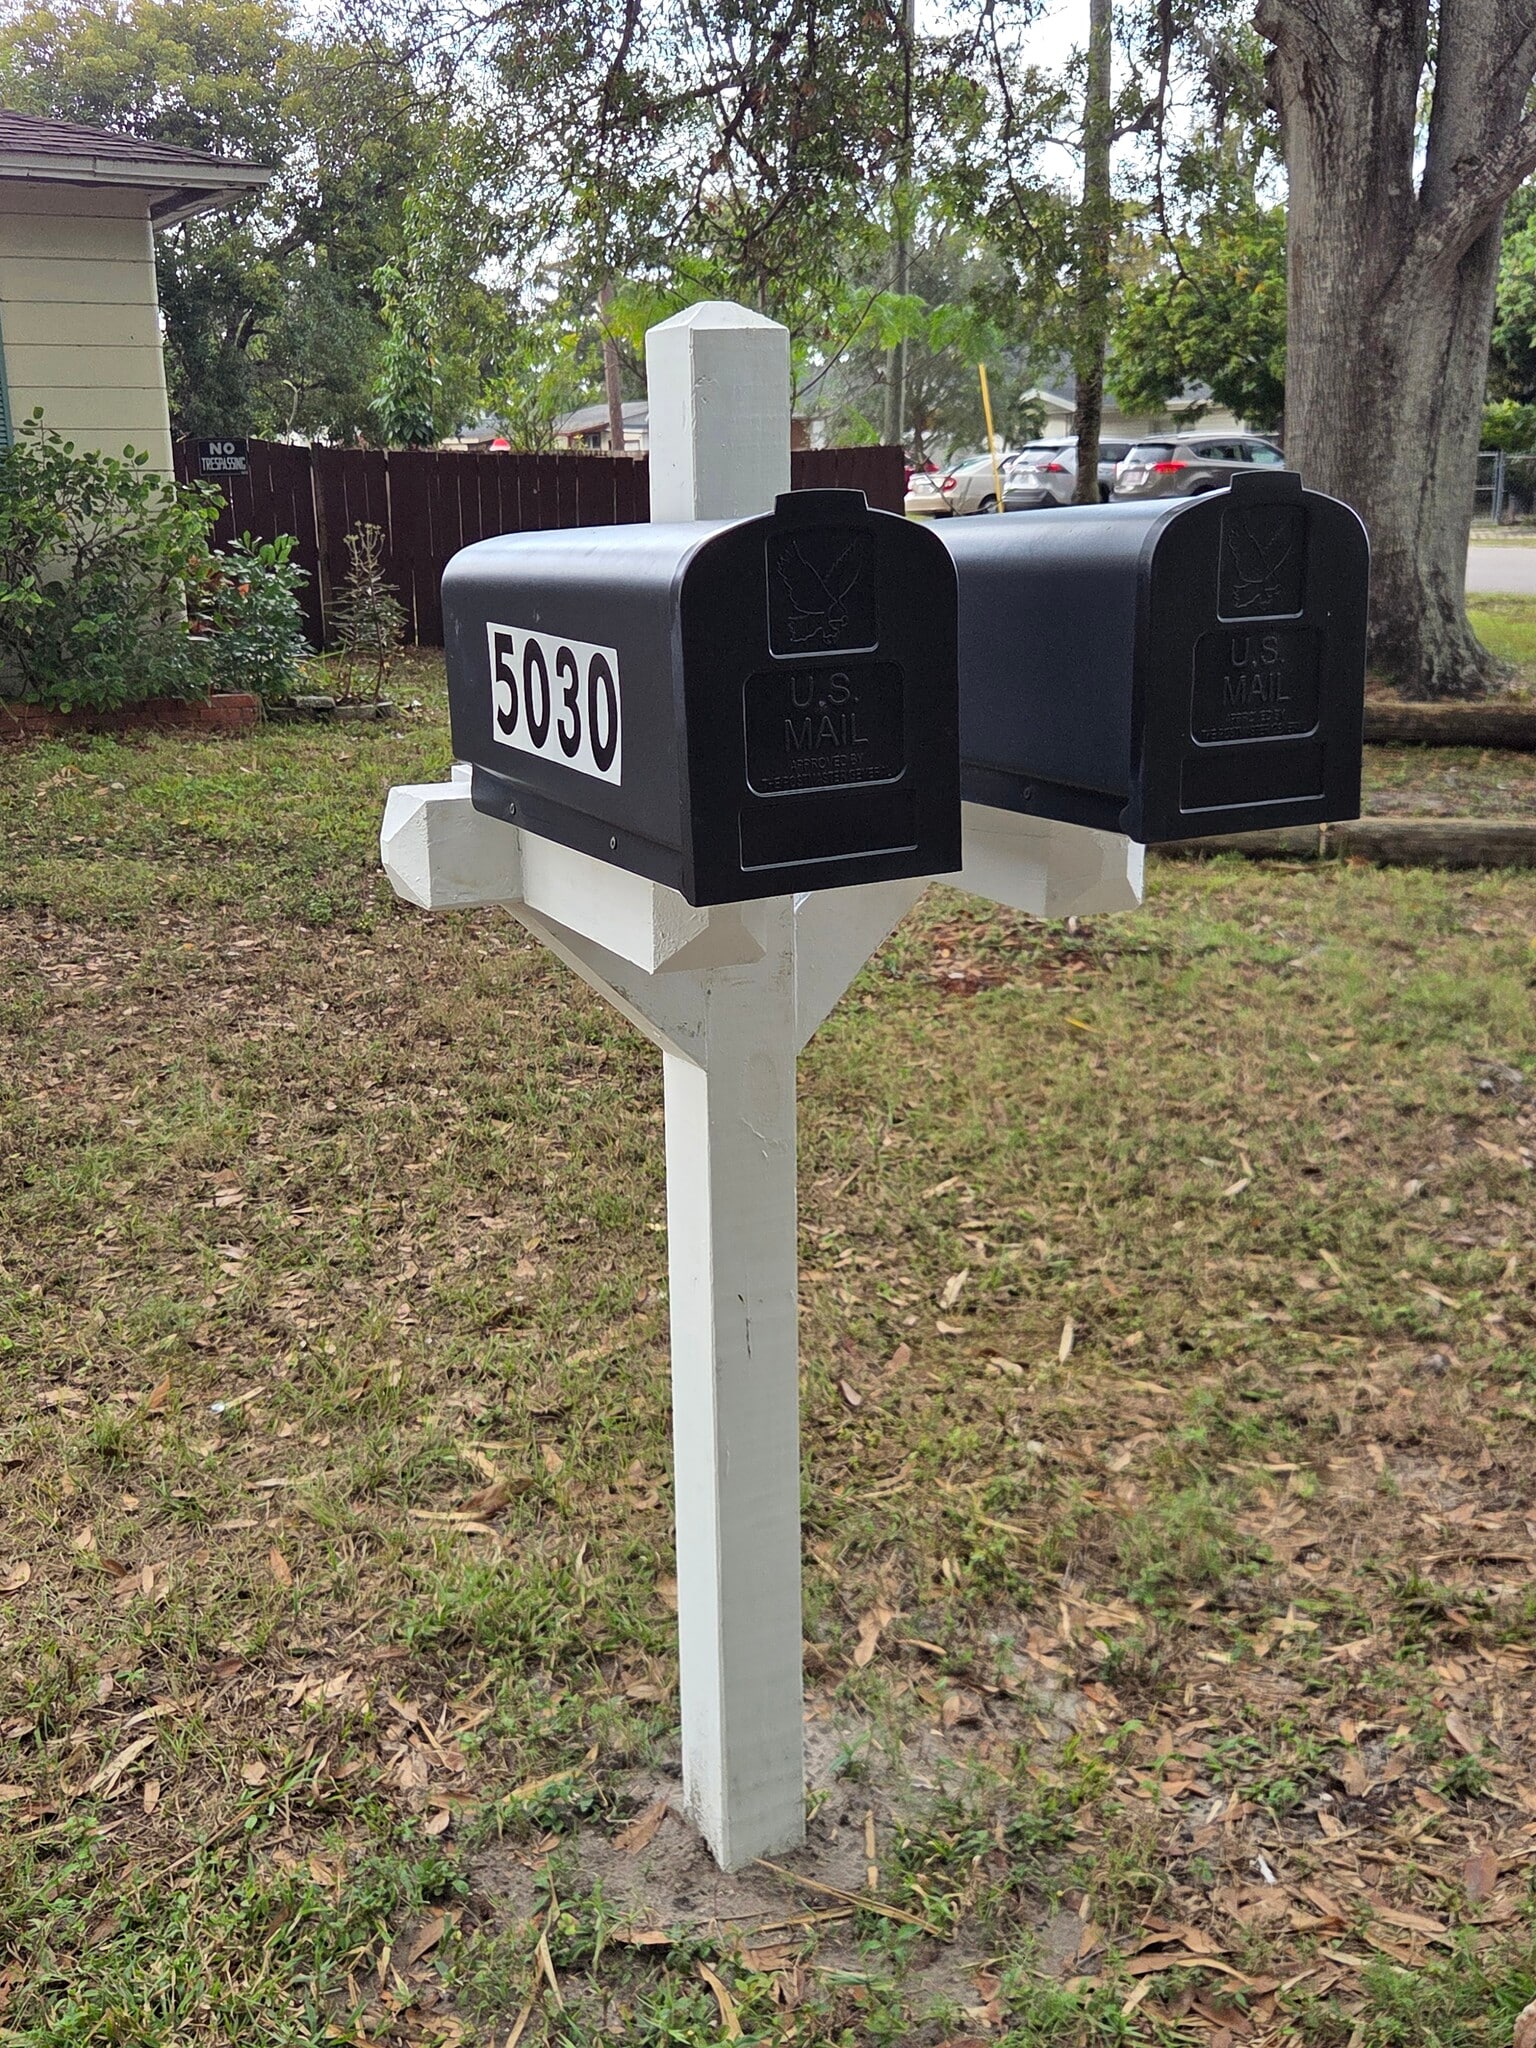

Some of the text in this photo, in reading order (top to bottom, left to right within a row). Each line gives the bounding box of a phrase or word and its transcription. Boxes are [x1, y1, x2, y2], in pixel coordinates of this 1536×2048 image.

[201, 456, 247, 471] TRESPASSING
[209, 442, 235, 455] NO
[1231, 635, 1285, 668] U.S.
[494, 631, 618, 773] 5030
[790, 672, 860, 709] U.S.
[1223, 672, 1291, 706] MAIL
[784, 712, 870, 752] MAIL
[790, 752, 864, 771] APPROVED BY
